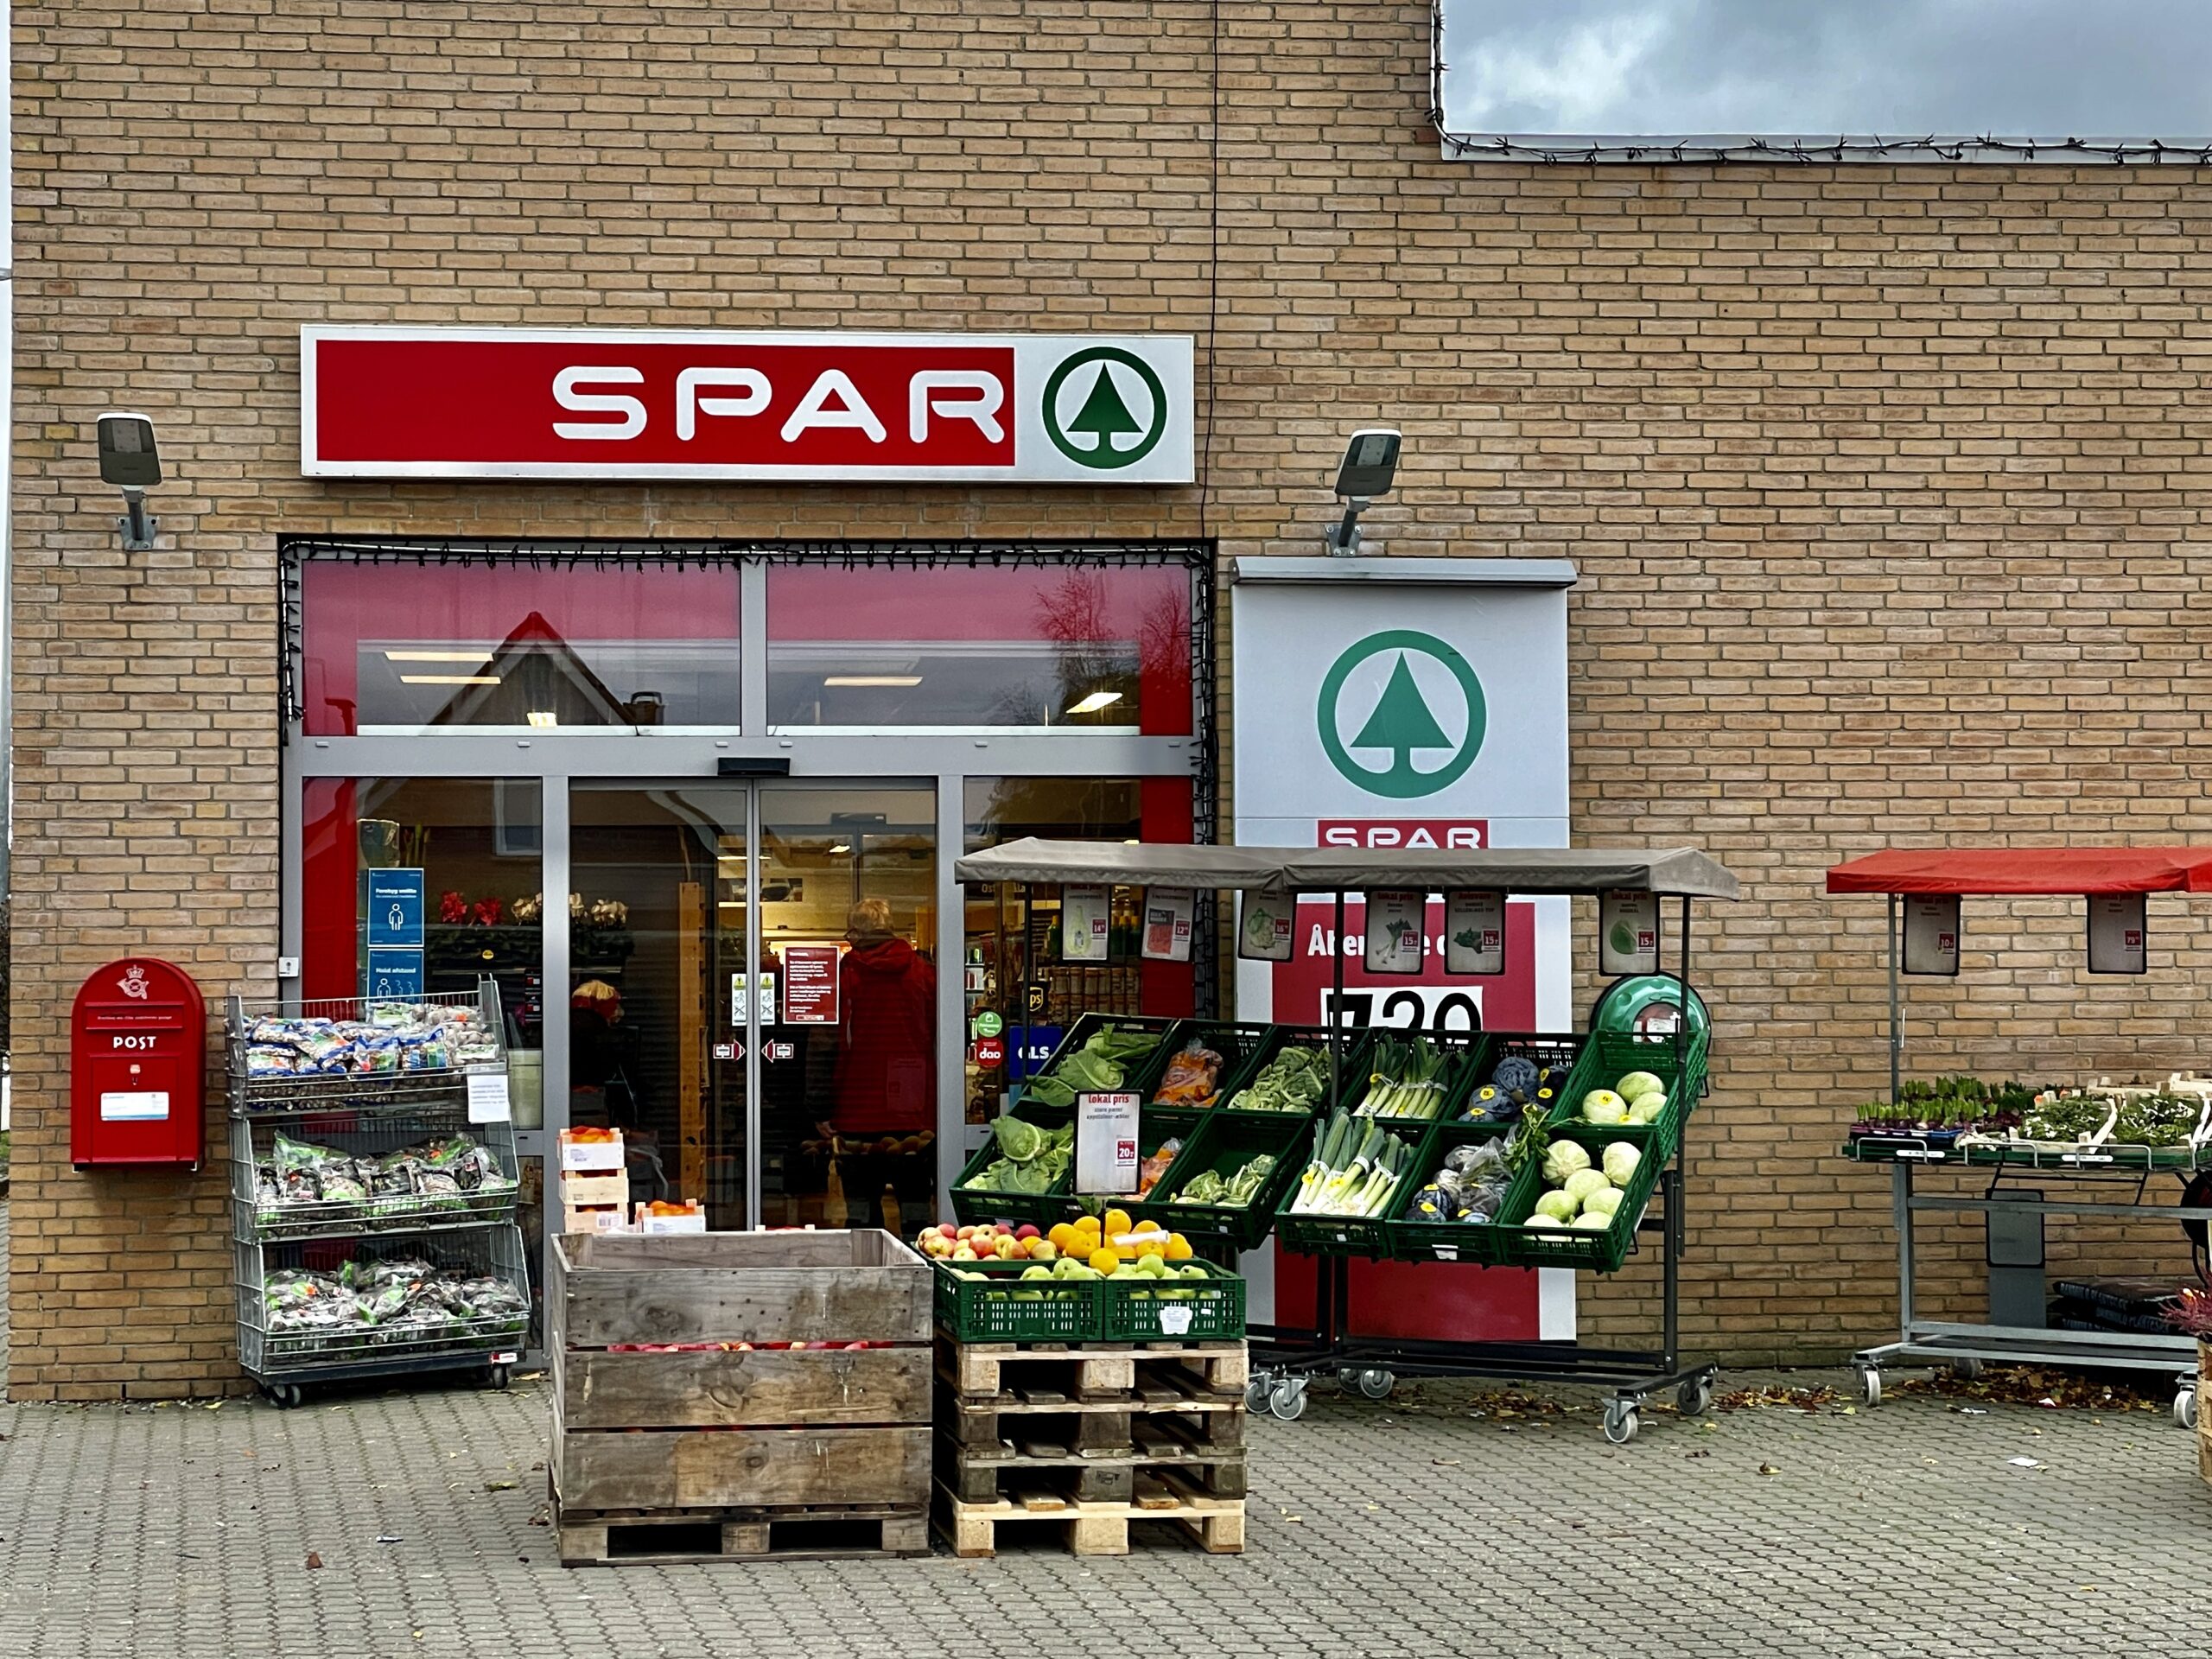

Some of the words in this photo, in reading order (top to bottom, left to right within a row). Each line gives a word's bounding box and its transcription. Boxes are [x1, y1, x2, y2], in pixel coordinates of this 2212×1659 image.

[551, 365, 1005, 444] SPAR
[1325, 827, 1481, 849] SPAR
[113, 1036, 156, 1051] POST
[979, 1047, 1001, 1059] dao
[1089, 1094, 1111, 1103] lokal
[1113, 1094, 1130, 1106] pris
